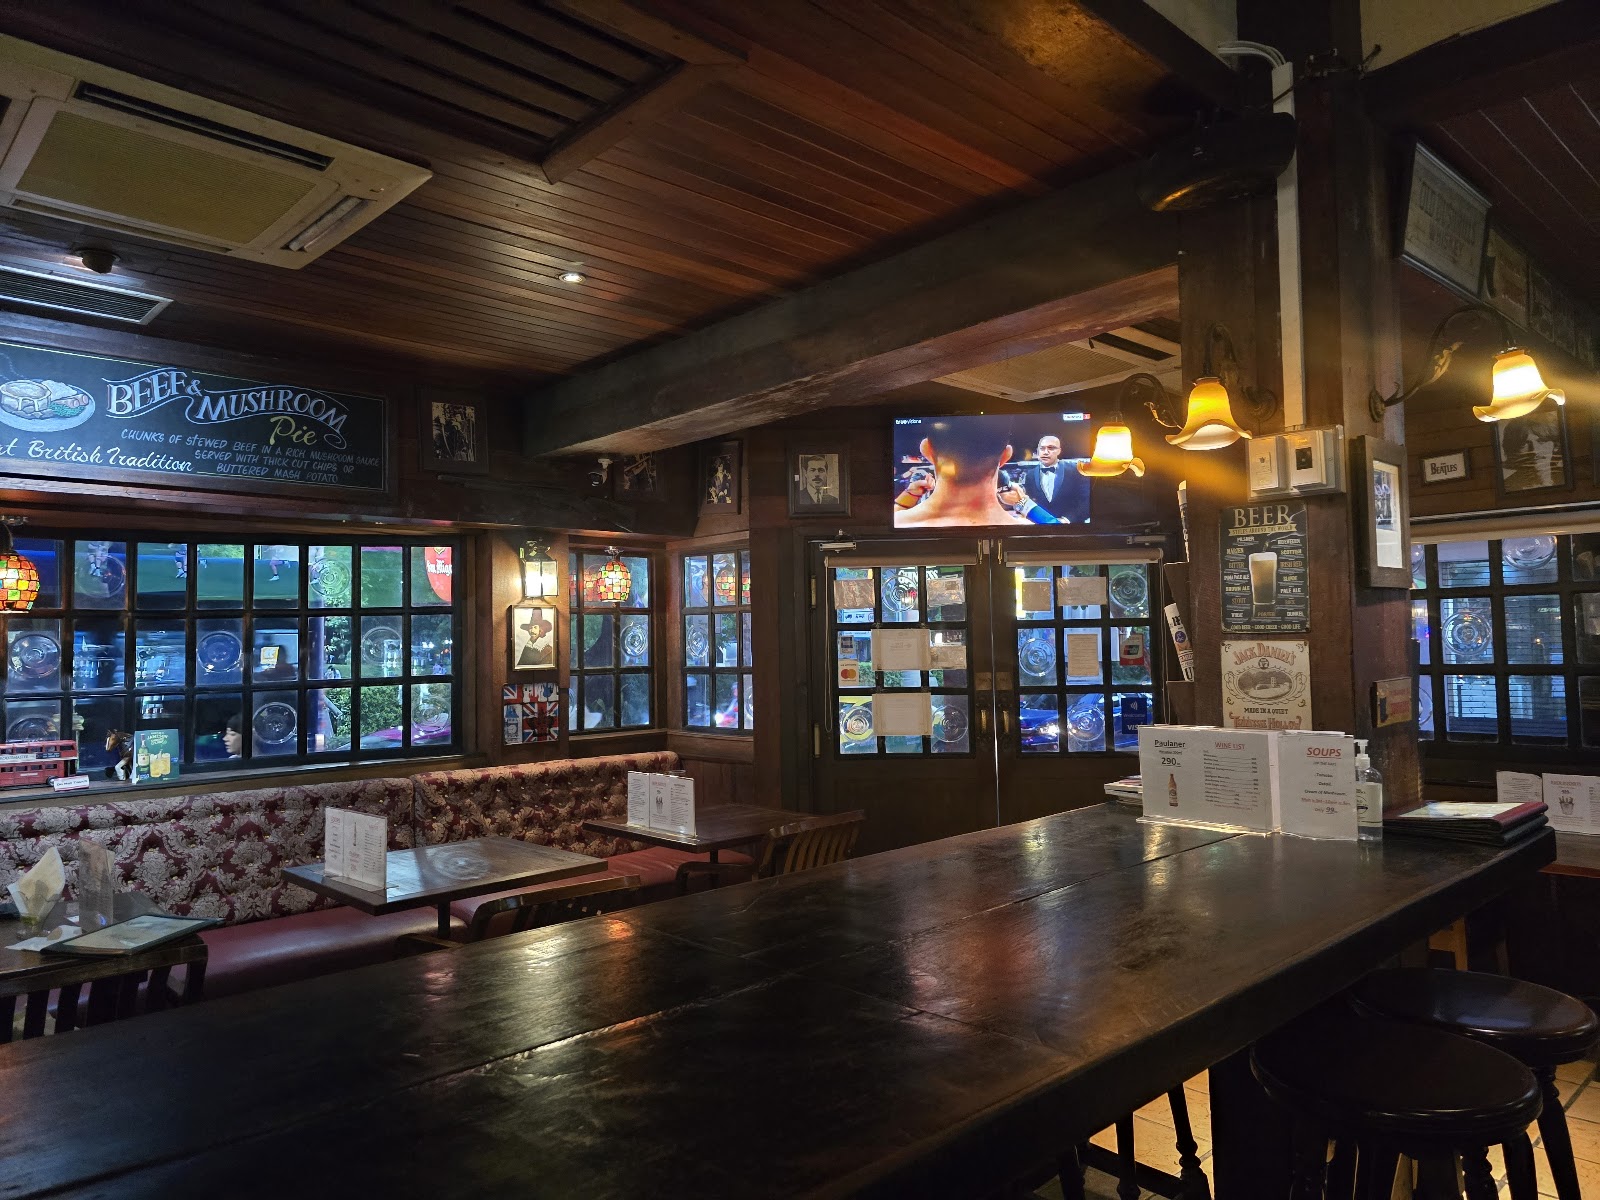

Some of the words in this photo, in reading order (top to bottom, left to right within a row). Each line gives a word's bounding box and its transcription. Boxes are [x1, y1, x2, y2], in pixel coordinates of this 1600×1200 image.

[106, 370, 188, 415] BEEF
[185, 379, 203, 397] &
[194, 388, 348, 433] MUSHROOM
[269, 415, 318, 446] Pie
[28, 440, 104, 464] British
[106, 446, 195, 472] Tradition
[120, 428, 165, 443] CHUNKS
[168, 434, 182, 444] OF
[233, 441, 258, 453] BEEF
[261, 445, 273, 454] IN
[275, 447, 283, 456] A
[285, 447, 307, 459] RICH
[309, 450, 354, 464] MUSHROOM
[194, 449, 232, 461] SERVED
[235, 453, 260, 464] WITH
[263, 456, 290, 467] THICK
[291, 459, 310, 469] CUT
[312, 461, 338, 473] CHIPS
[1430, 462, 1458, 476] BEATLES
[216, 462, 269, 476] BUTTERED
[273, 468, 302, 480] MASH
[306, 471, 339, 484] POTATO
[1233, 504, 1294, 528] BEER
[1232, 646, 1257, 666] JACK
[1243, 707, 1260, 715] MADE
[1154, 739, 1186, 750] Paulaner
[1214, 741, 1232, 750] WINE
[1306, 747, 1342, 758] SOUPS
